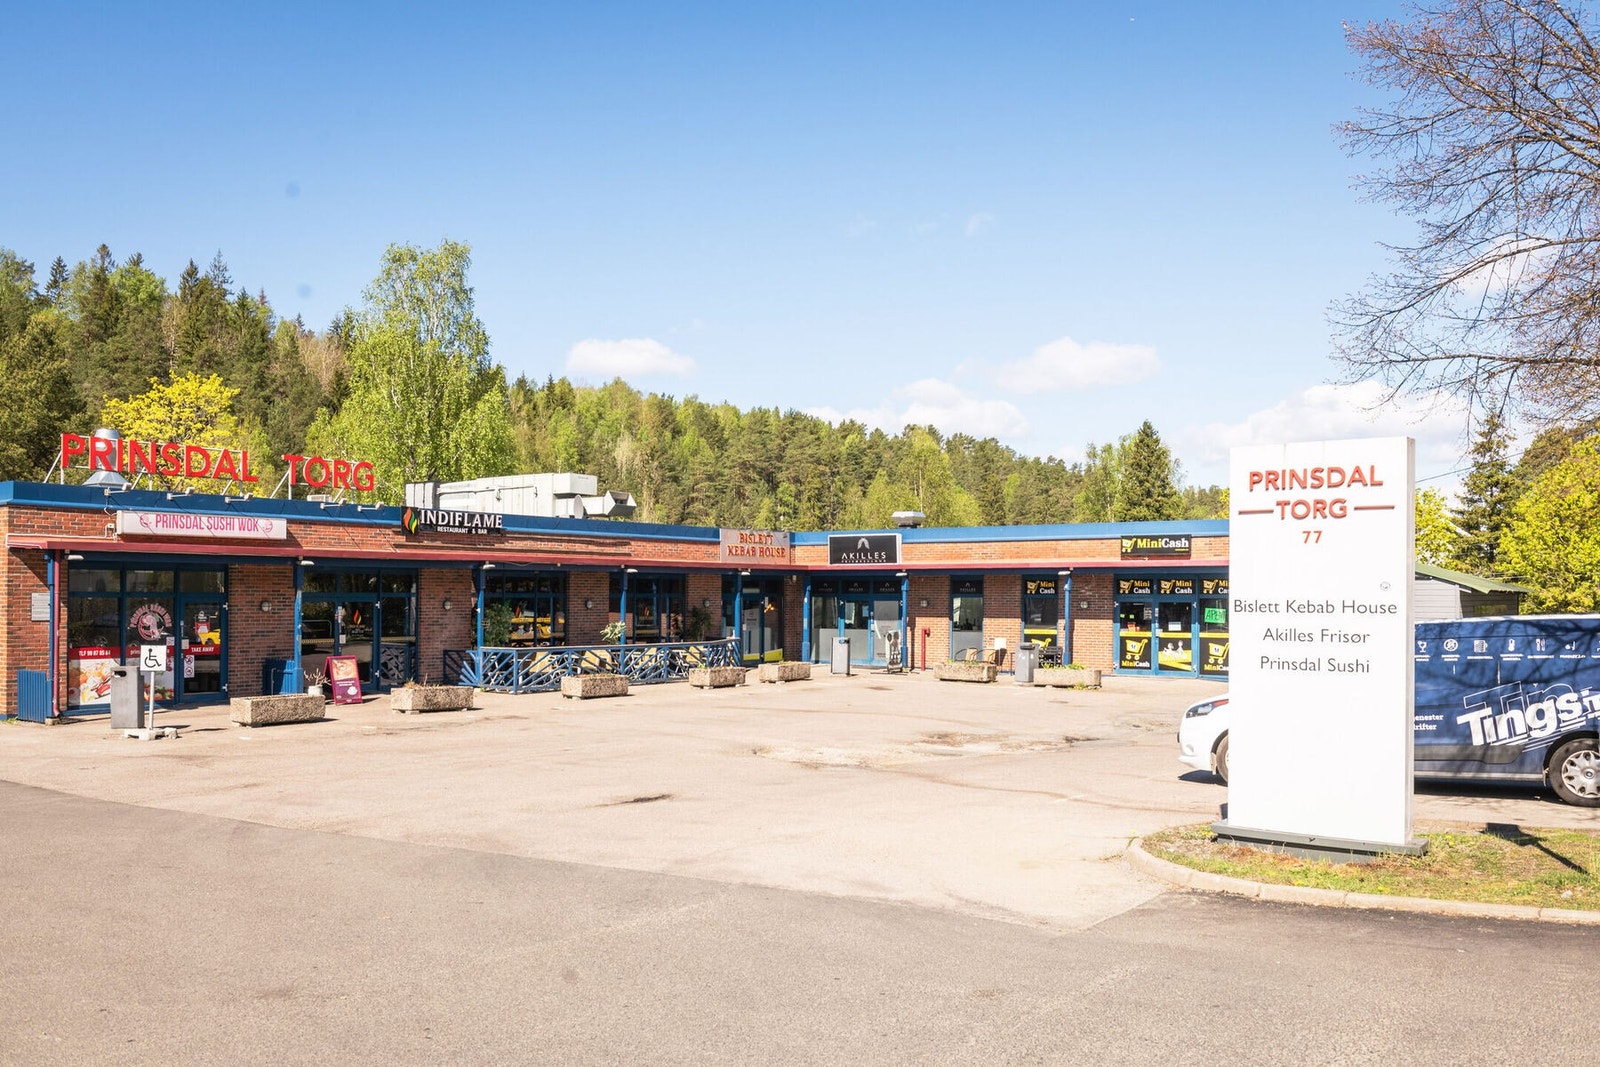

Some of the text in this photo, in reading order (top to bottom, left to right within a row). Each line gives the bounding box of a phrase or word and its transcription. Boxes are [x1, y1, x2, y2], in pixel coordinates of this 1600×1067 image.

[61, 433, 374, 491] PRINSDAL TORG
[1249, 465, 1384, 492] PRINSDAL
[1276, 498, 1347, 520] TORG
[155, 513, 259, 532] PRINSDAL SUSHI WOK
[421, 509, 503, 528] INDIFLAME
[437, 526, 468, 534] RESTAURANT
[1302, 531, 1322, 544] 77
[739, 532, 774, 545] BISLETT
[1137, 538, 1189, 549] MiniCash
[727, 544, 786, 557] KEBAB HOUSE
[1233, 599, 1397, 615] Bislett Kebab House
[1263, 628, 1370, 644] Akilles Frisør
[1260, 656, 1370, 673] Prinsdal Sushi
